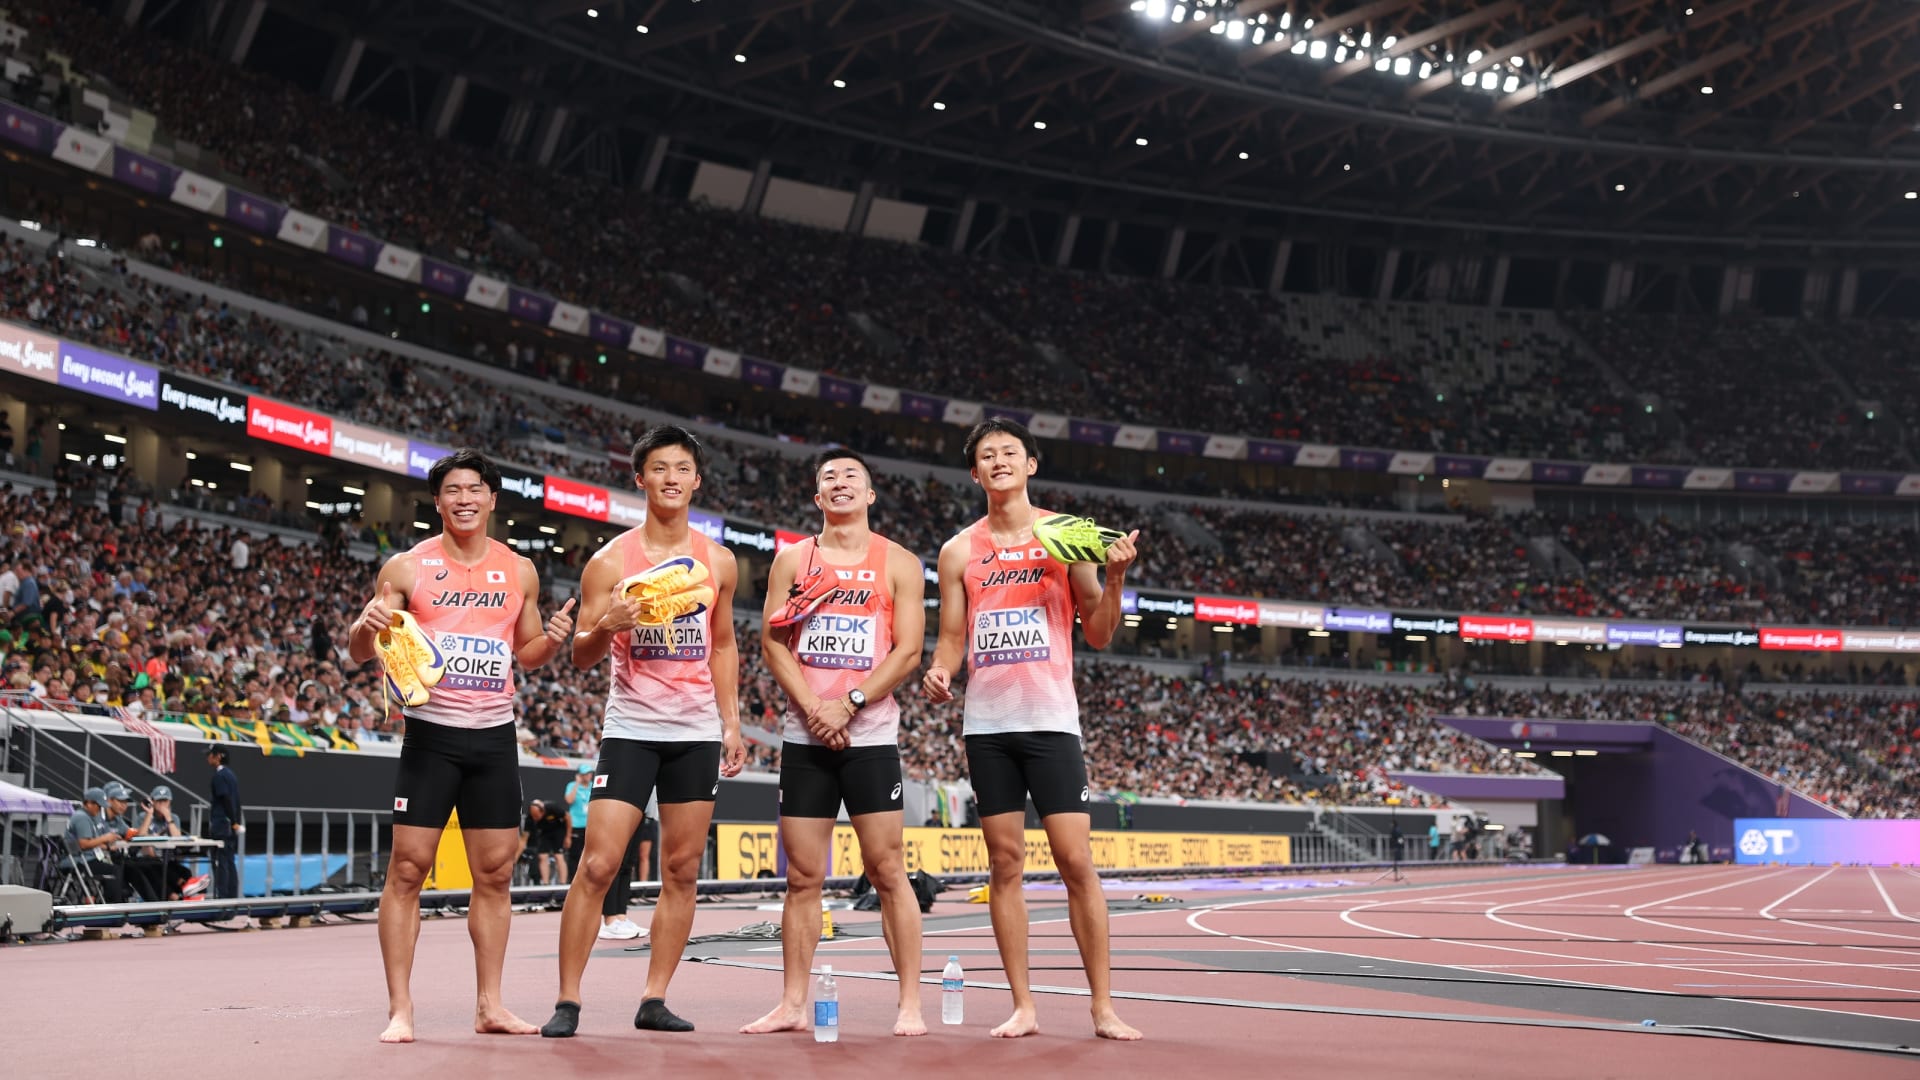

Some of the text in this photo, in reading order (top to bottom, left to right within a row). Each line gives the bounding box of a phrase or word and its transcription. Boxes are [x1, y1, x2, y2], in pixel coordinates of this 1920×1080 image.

[62, 355, 90, 384] Every
[162, 383, 187, 410] Every
[981, 567, 1045, 587] JAPAN
[432, 591, 507, 608] JAPAN
[823, 589, 871, 605] PAN
[821, 615, 870, 635] TDK
[989, 608, 1041, 628] TDK
[457, 636, 505, 657] TDK
[807, 635, 865, 654] KIRYU
[977, 629, 1045, 651] UZAWA
[941, 834, 990, 873] SEIK
